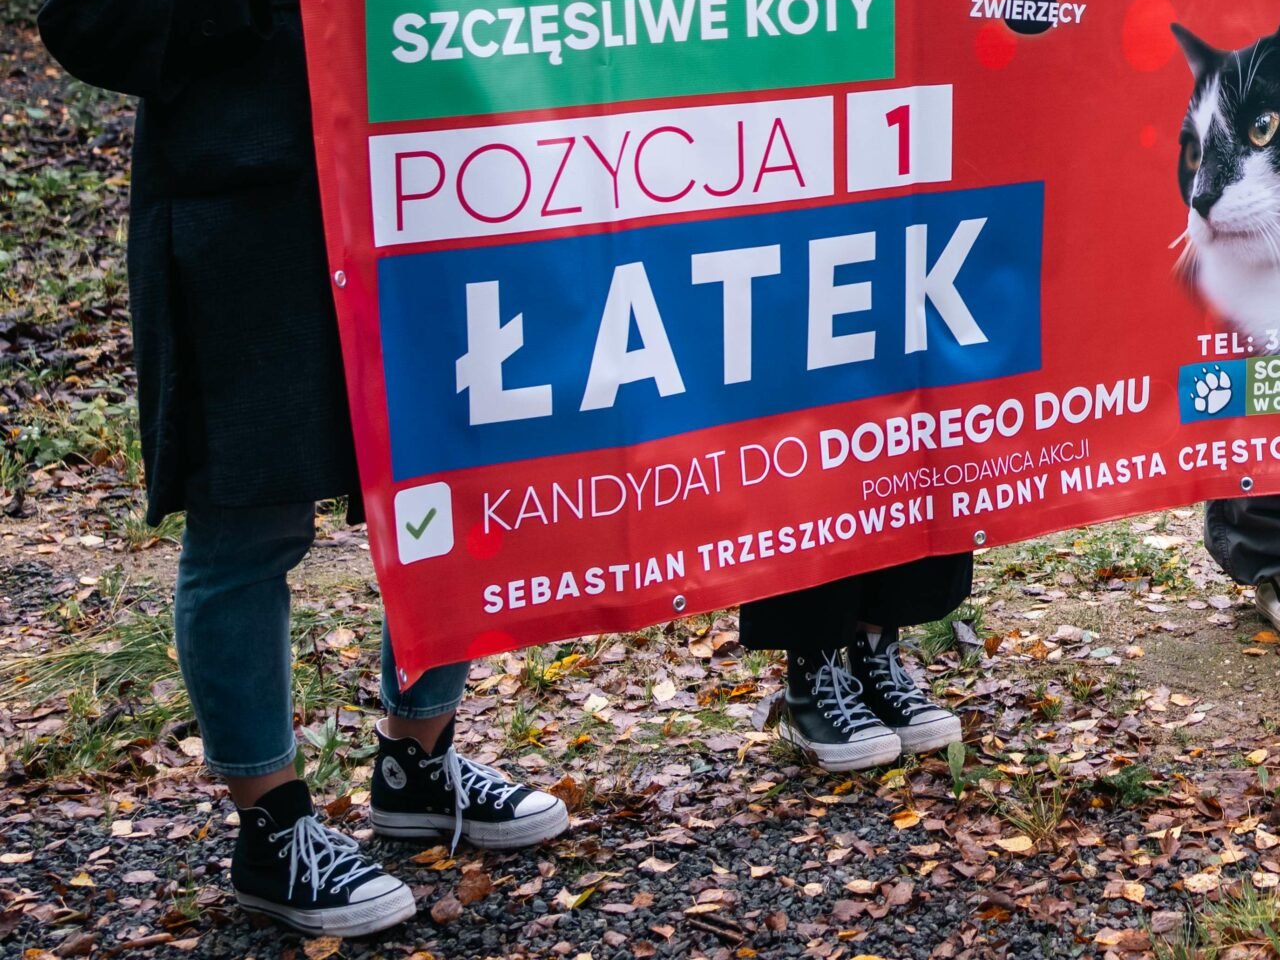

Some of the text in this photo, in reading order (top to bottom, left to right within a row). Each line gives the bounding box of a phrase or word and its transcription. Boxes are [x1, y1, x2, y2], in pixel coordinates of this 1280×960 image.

[395, 105, 912, 231] POZYCJA 1
[455, 217, 989, 426] ŁATEK
[1197, 333, 1254, 356] TEL:
[483, 375, 1150, 534] KANDYDAT DO DOBREGO DOMU
[1253, 397, 1268, 412] W
[862, 439, 1089, 500] POMYSŁODAWCA AKCJI
[483, 550, 687, 614] SEBASTIAN
[698, 495, 935, 571] TRZESZKOWSKI
[951, 473, 1048, 517] RADNY
[1060, 460, 1165, 495] MIASTA
